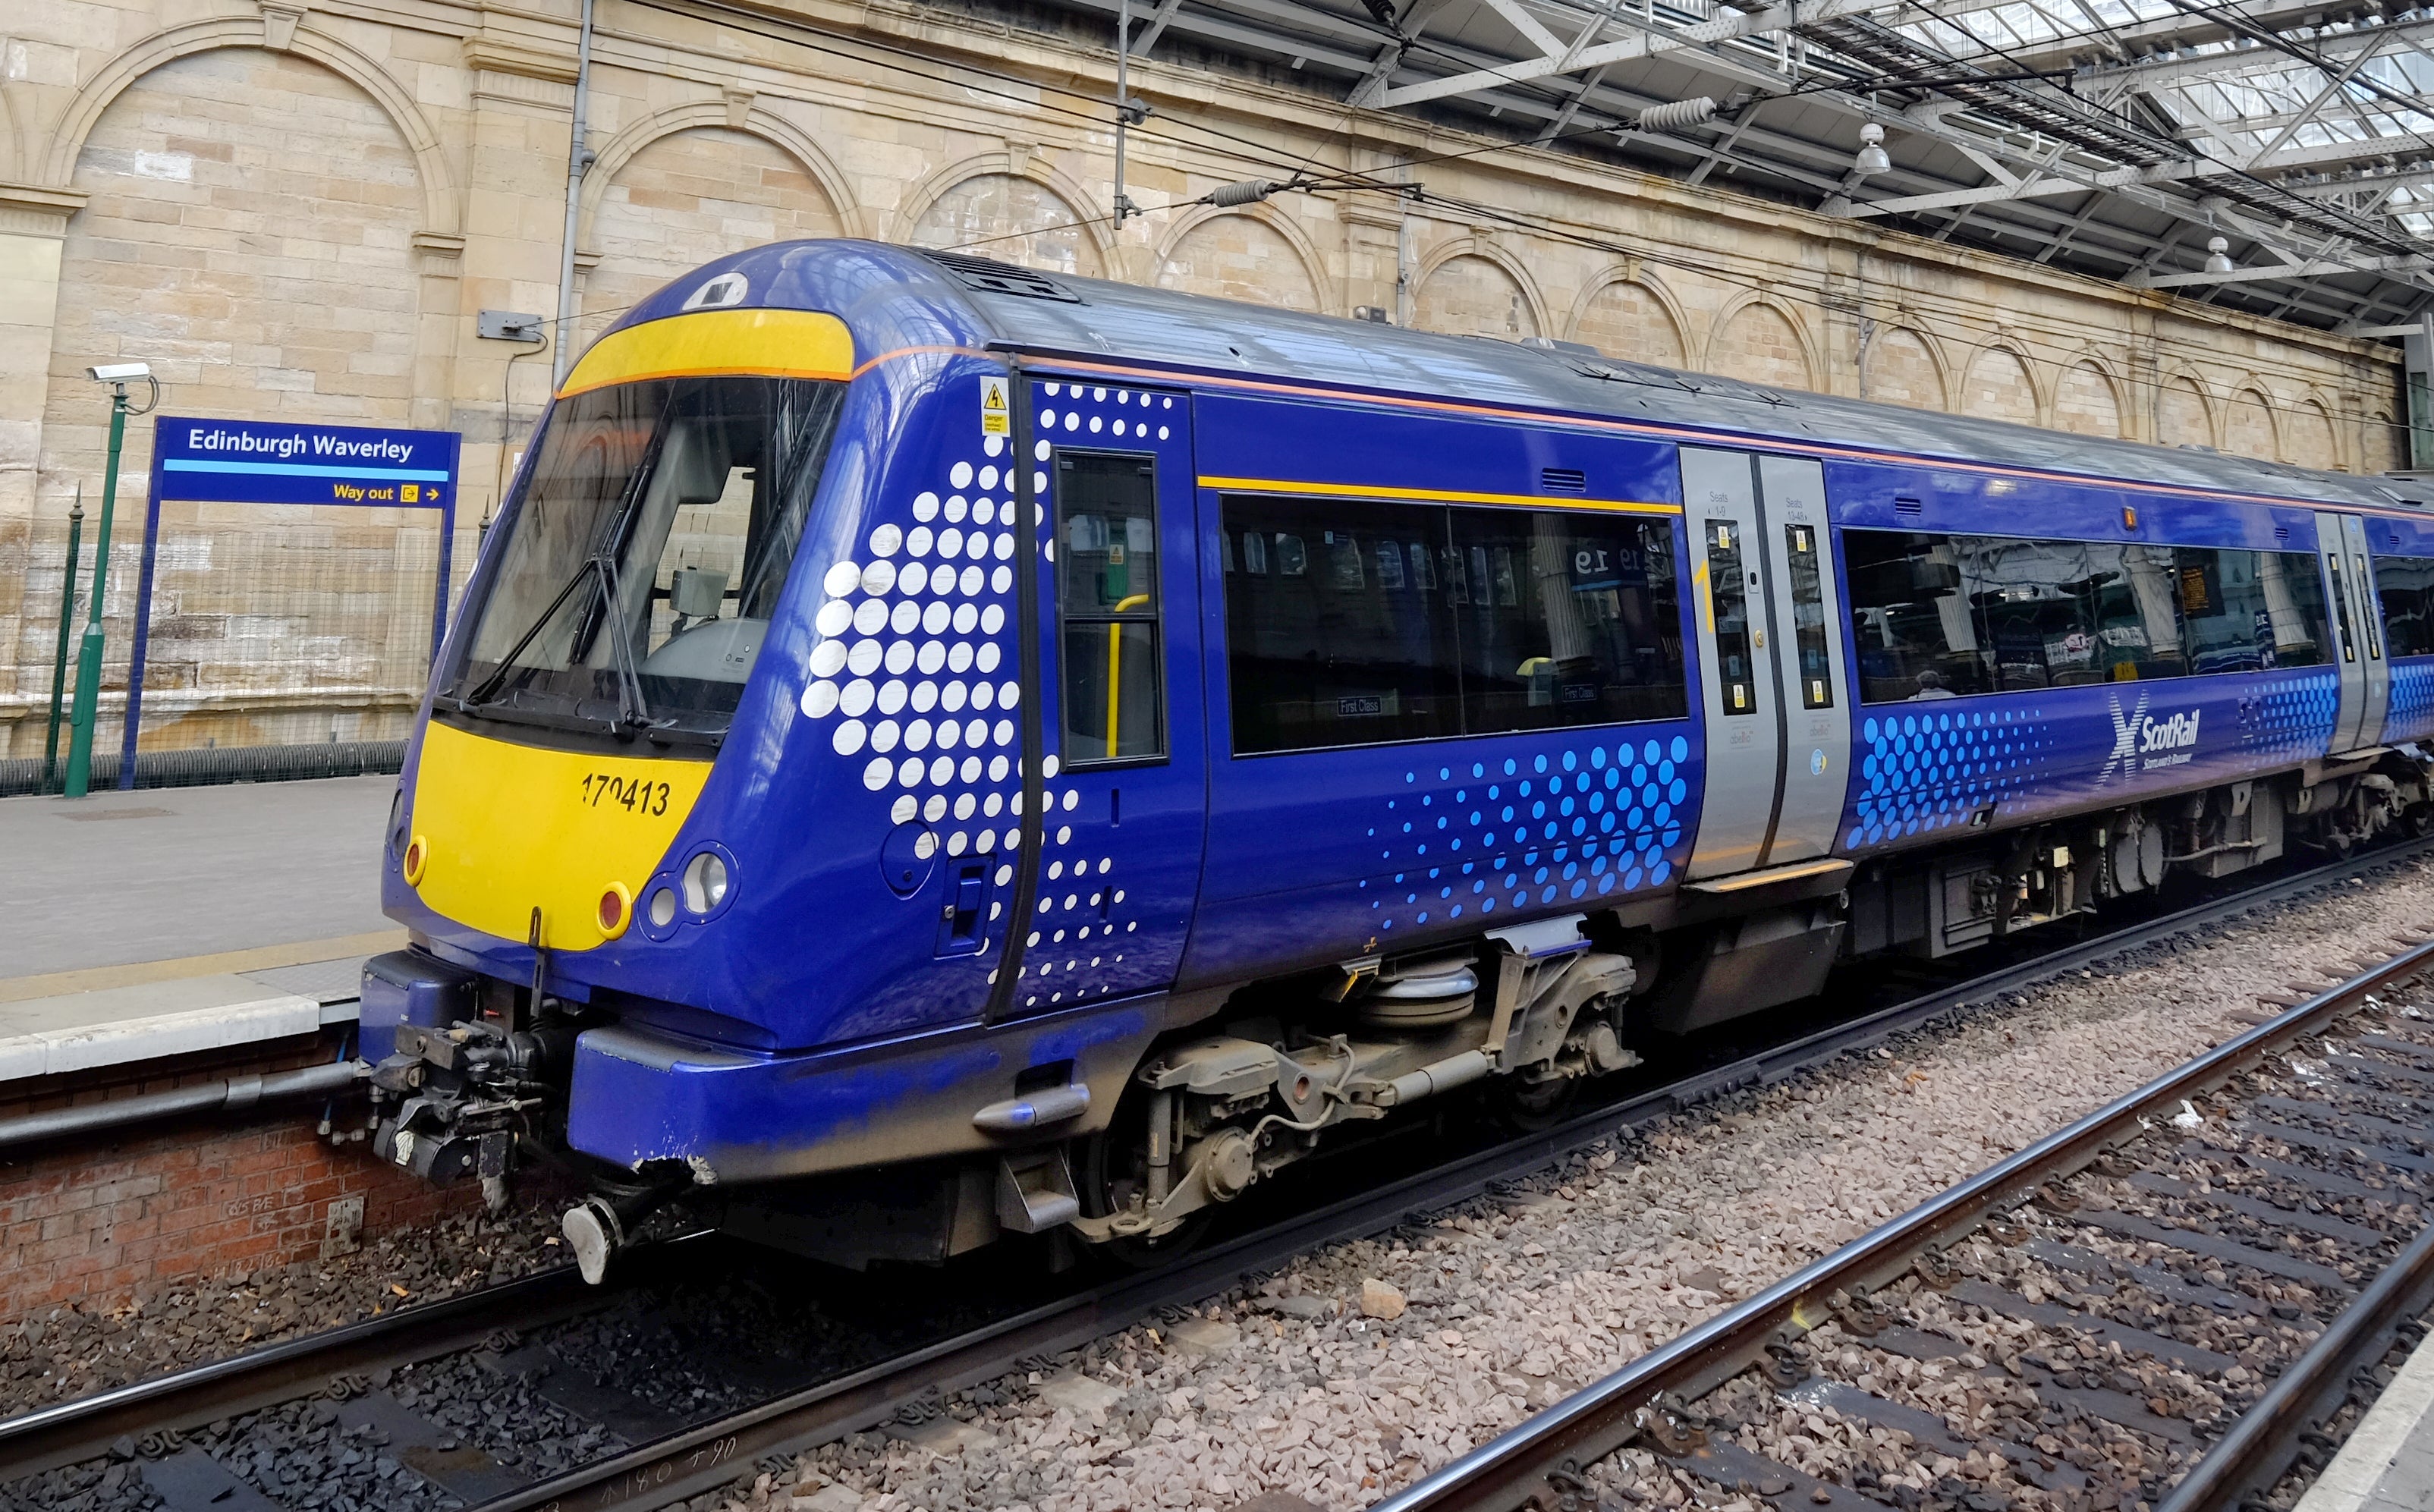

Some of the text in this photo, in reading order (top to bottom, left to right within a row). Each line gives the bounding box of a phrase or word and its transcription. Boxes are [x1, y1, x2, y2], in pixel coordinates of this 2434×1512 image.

[188, 429, 413, 463] Edinburgh Waverley
[334, 484, 393, 501] Way out
[1709, 492, 1728, 503] Seats
[1786, 498, 1803, 508] Seats
[1694, 559, 1714, 633] 1
[1341, 699, 1379, 713] First Class
[2140, 709, 2200, 753] ScotRail
